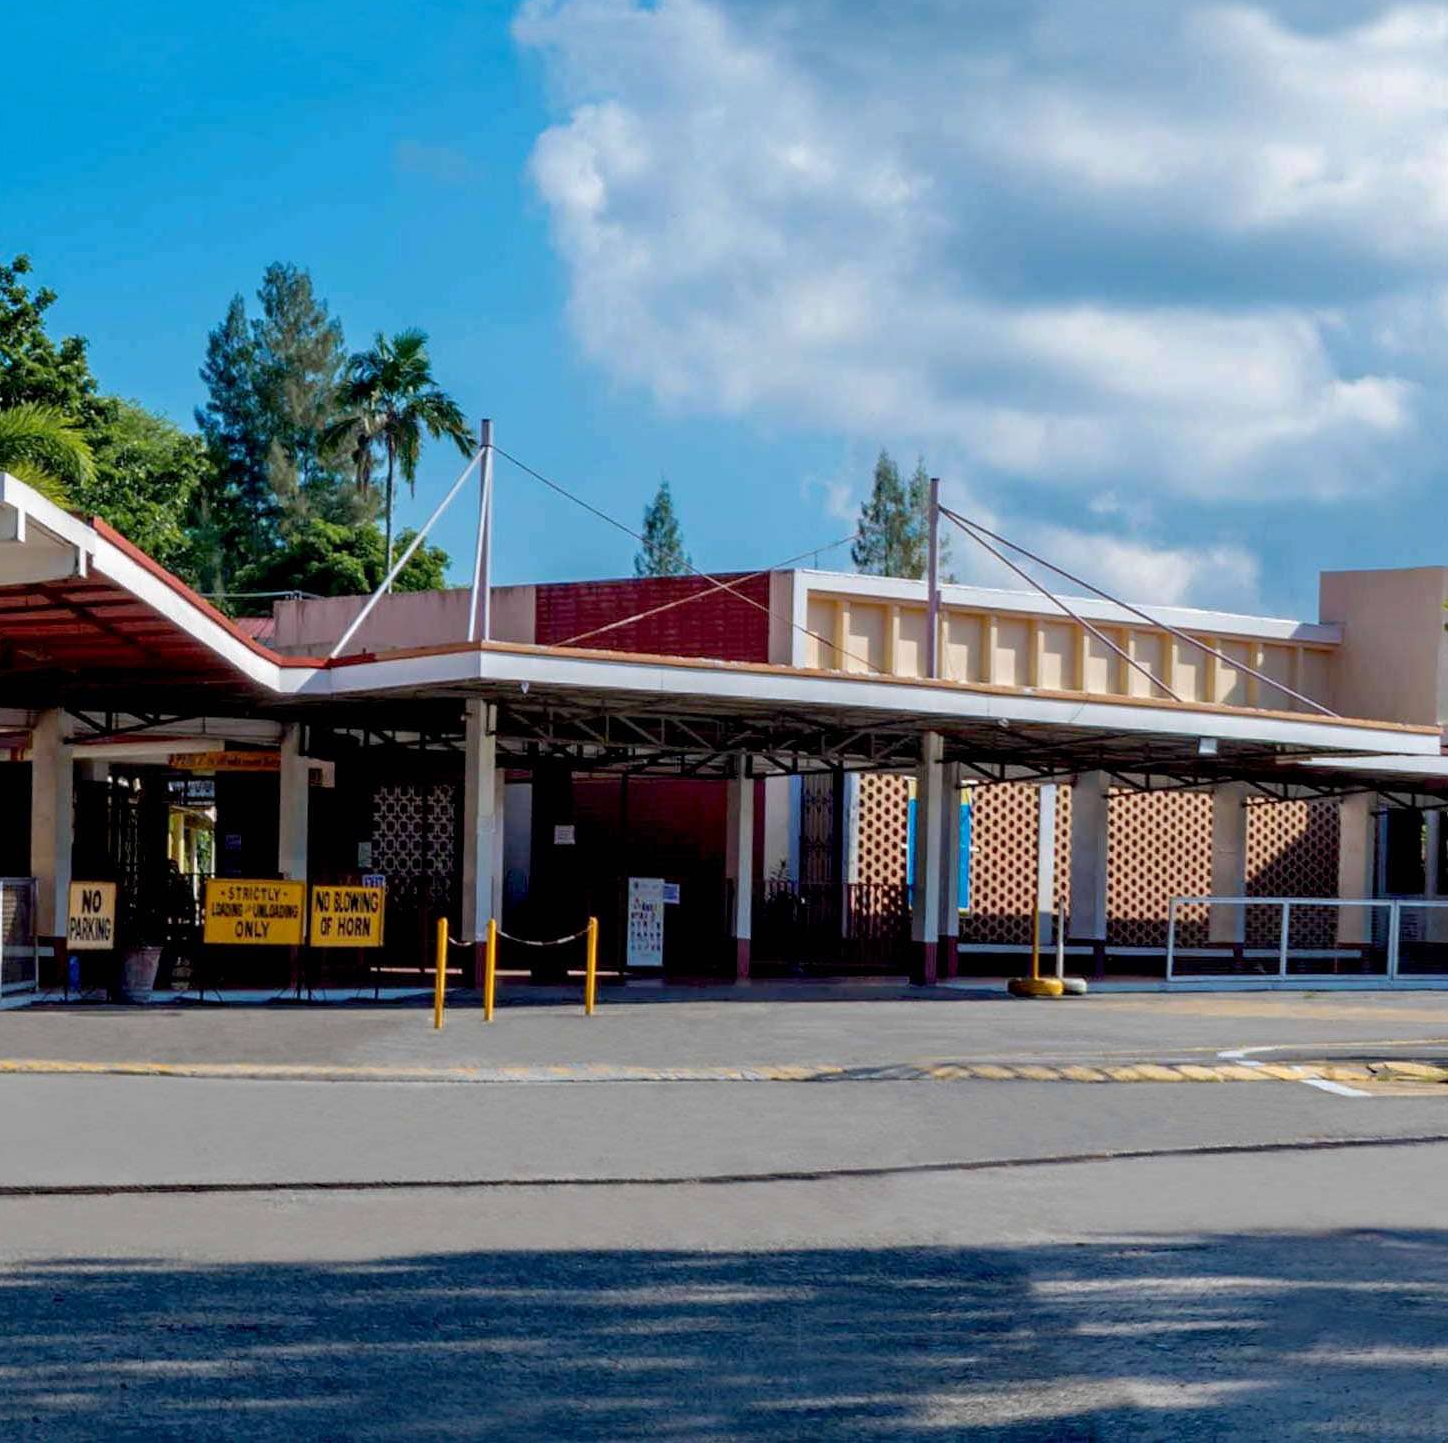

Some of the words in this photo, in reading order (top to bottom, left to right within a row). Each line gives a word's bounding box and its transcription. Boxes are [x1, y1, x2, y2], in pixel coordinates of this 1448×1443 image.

[82, 889, 102, 914] NO
[228, 885, 281, 901] STRICTLY
[315, 891, 330, 912] NO
[334, 891, 379, 913] BLOWING
[69, 917, 111, 941] PARKING
[234, 921, 271, 938] ONLY
[321, 917, 333, 936] OF
[337, 917, 371, 937] HORN
